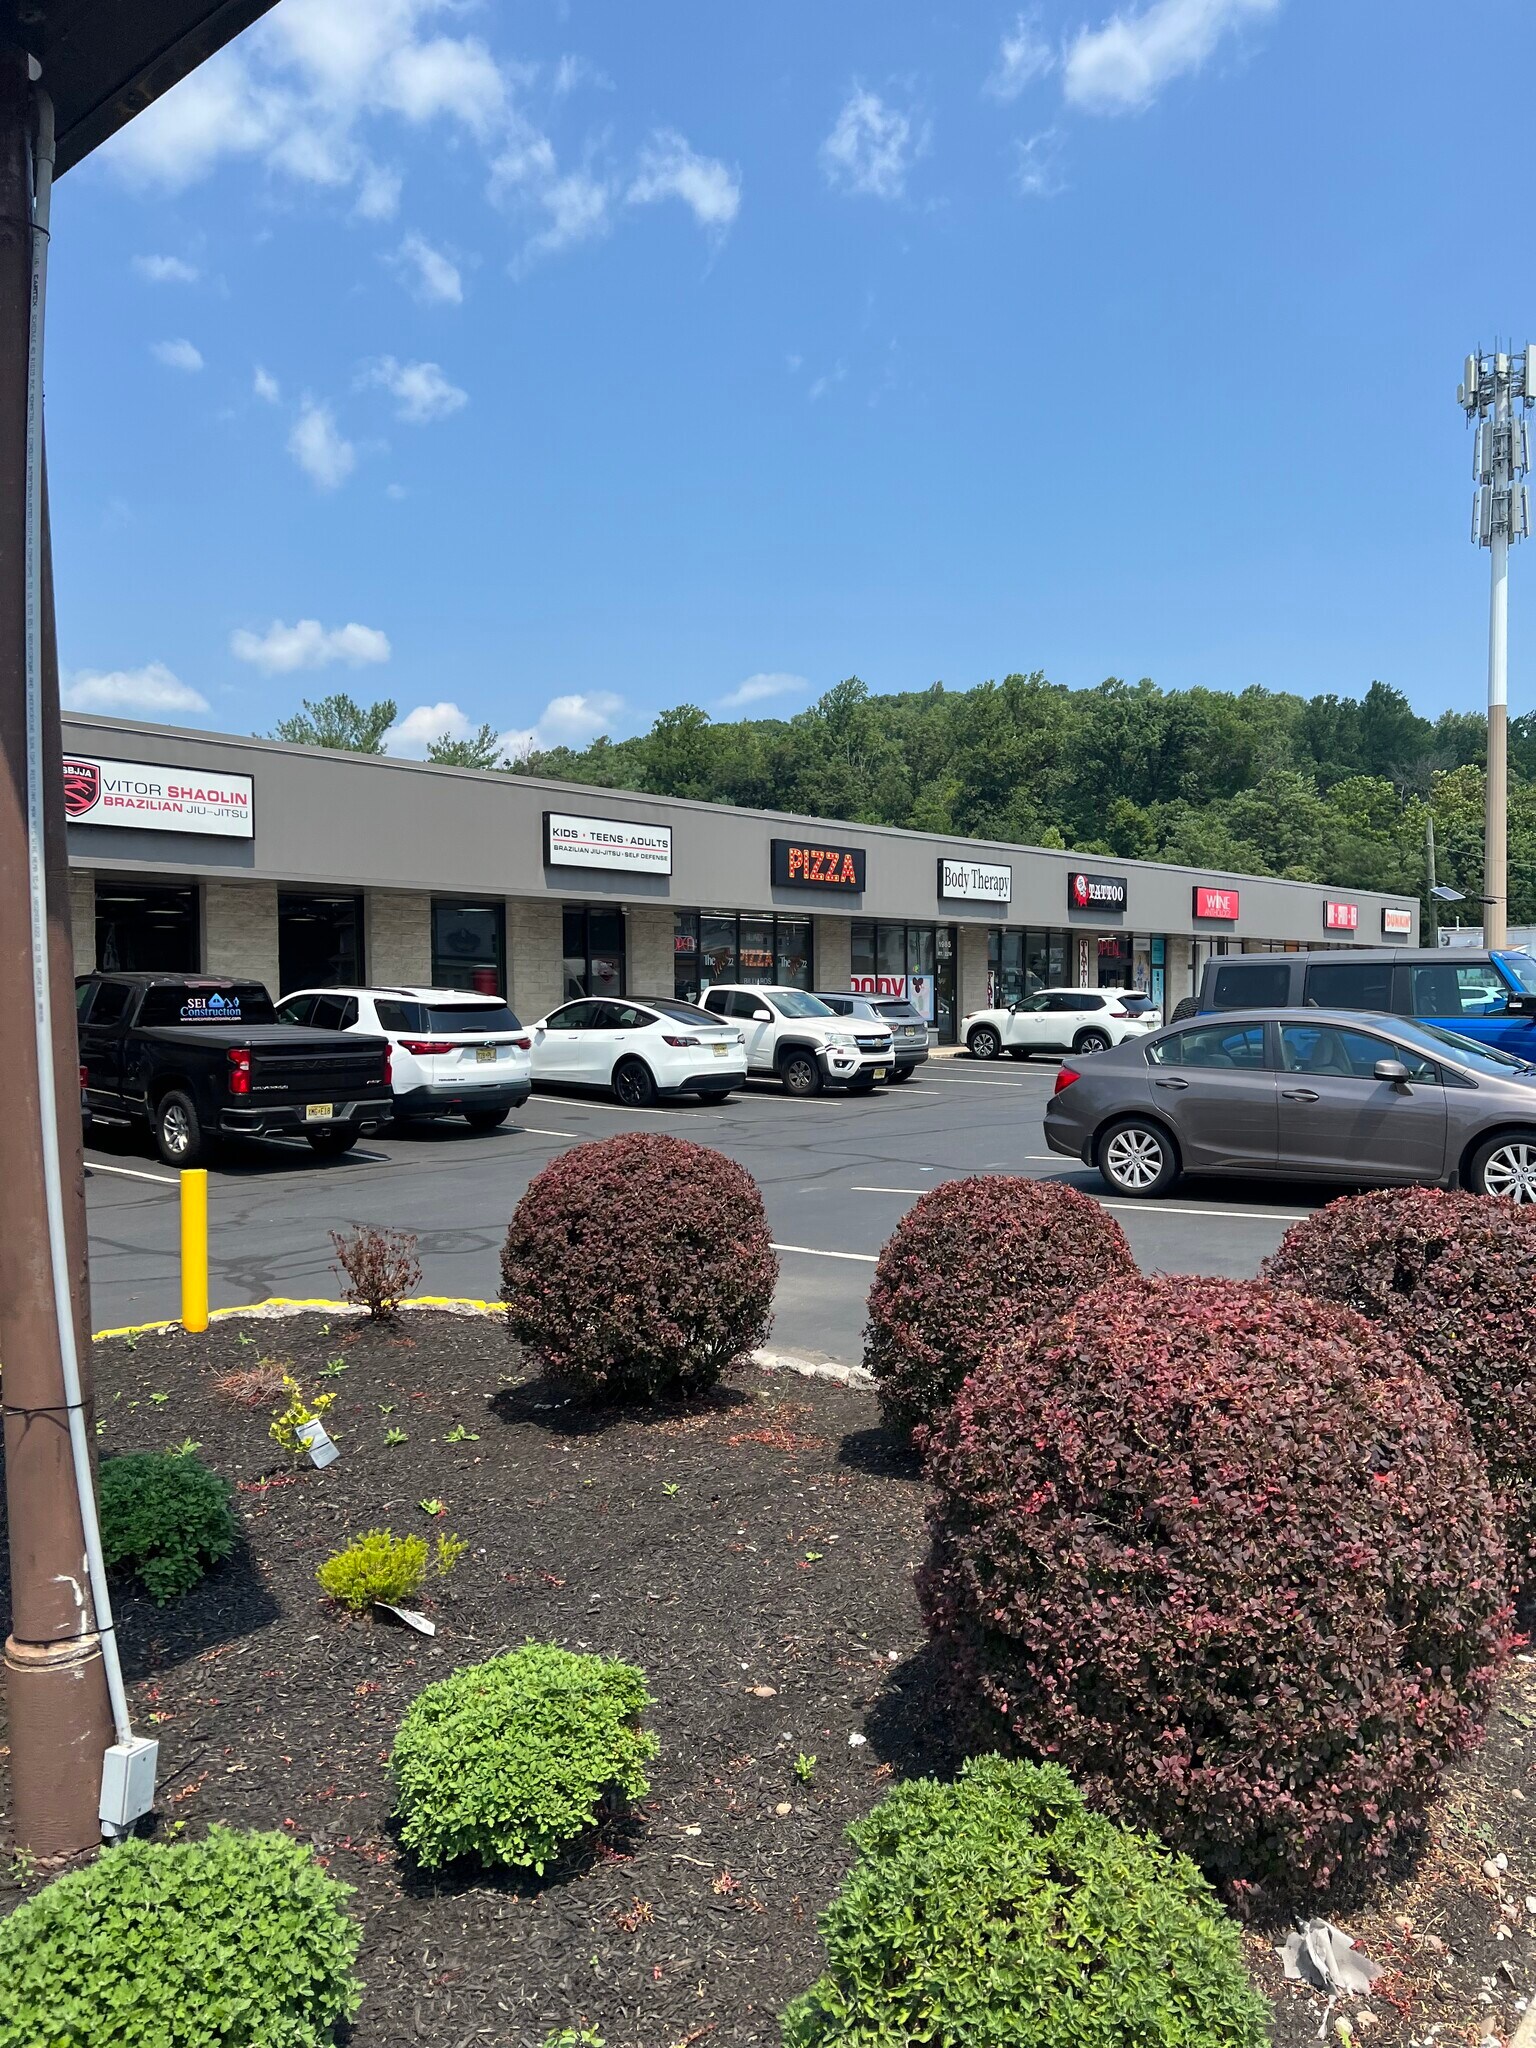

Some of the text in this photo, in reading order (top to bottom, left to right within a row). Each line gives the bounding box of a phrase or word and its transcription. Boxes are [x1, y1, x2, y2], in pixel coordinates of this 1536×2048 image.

[103, 778, 248, 805] VITOR SHAOLIN
[104, 796, 248, 819] BRAZILIAN JIU-JITSU
[552, 828, 669, 848] KIDS TEENS ADULTS
[553, 844, 590, 854] BRAZILIAN
[590, 849, 621, 857] JIU-JITSU
[640, 853, 668, 861] DEFENSE
[789, 847, 856, 884] PIZZA
[944, 866, 1010, 897] Body Therapy
[1088, 883, 1124, 902] TATTOO
[1206, 892, 1231, 910] WINE
[704, 954, 716, 966] The
[180, 1006, 242, 1017] Construction
[187, 998, 206, 1009] SEI
